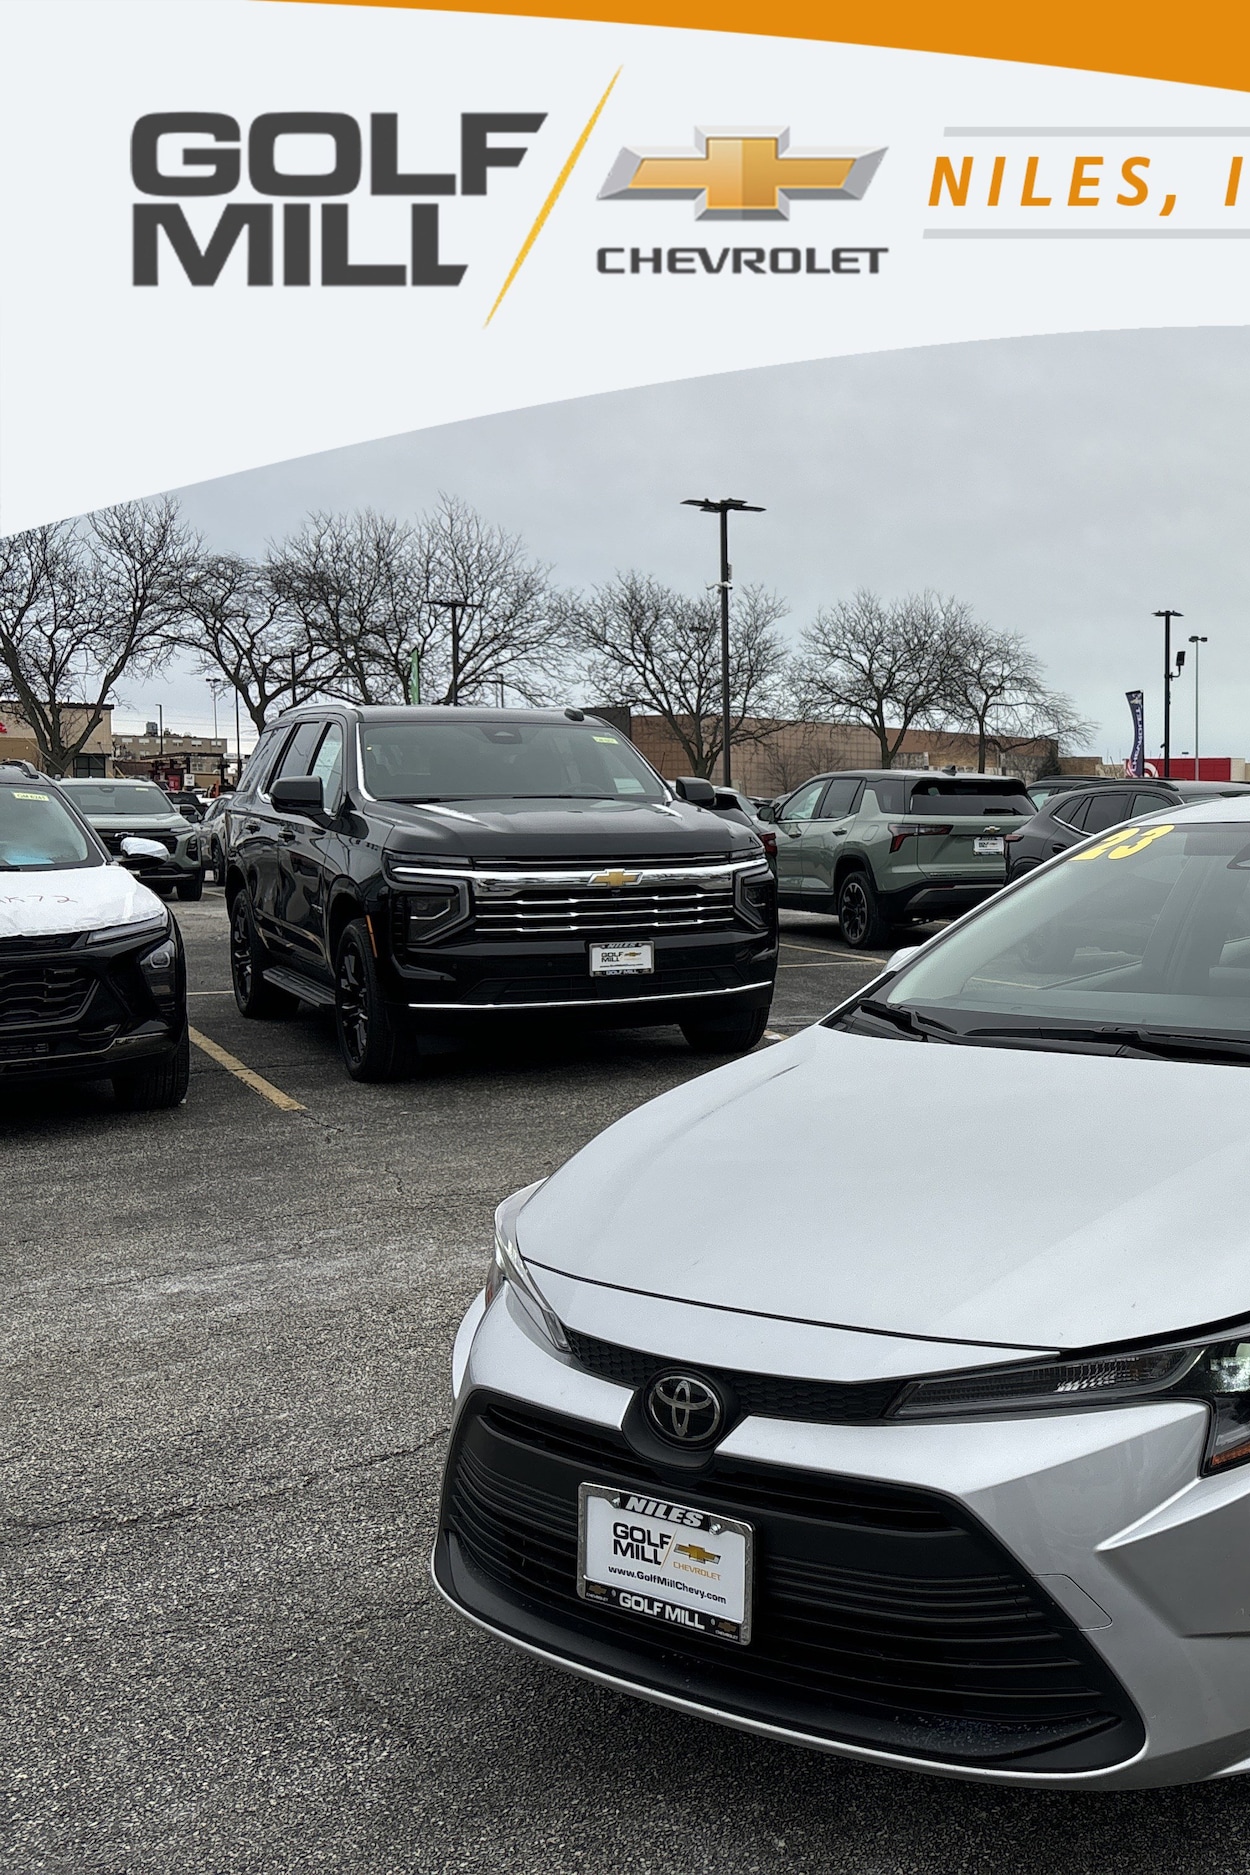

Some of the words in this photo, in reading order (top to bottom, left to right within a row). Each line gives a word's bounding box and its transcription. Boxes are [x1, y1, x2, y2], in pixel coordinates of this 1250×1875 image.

[1068, 824, 1176, 861] 23
[625, 1496, 704, 1528] NILES
[612, 1521, 672, 1550] GOLF
[613, 1538, 662, 1566] MILL
[608, 1565, 727, 1605] www.GolfMillChevy.com
[673, 1561, 722, 1582] CHEVROLET
[619, 1592, 663, 1617] GOLF
[664, 1605, 705, 1630] MILL
